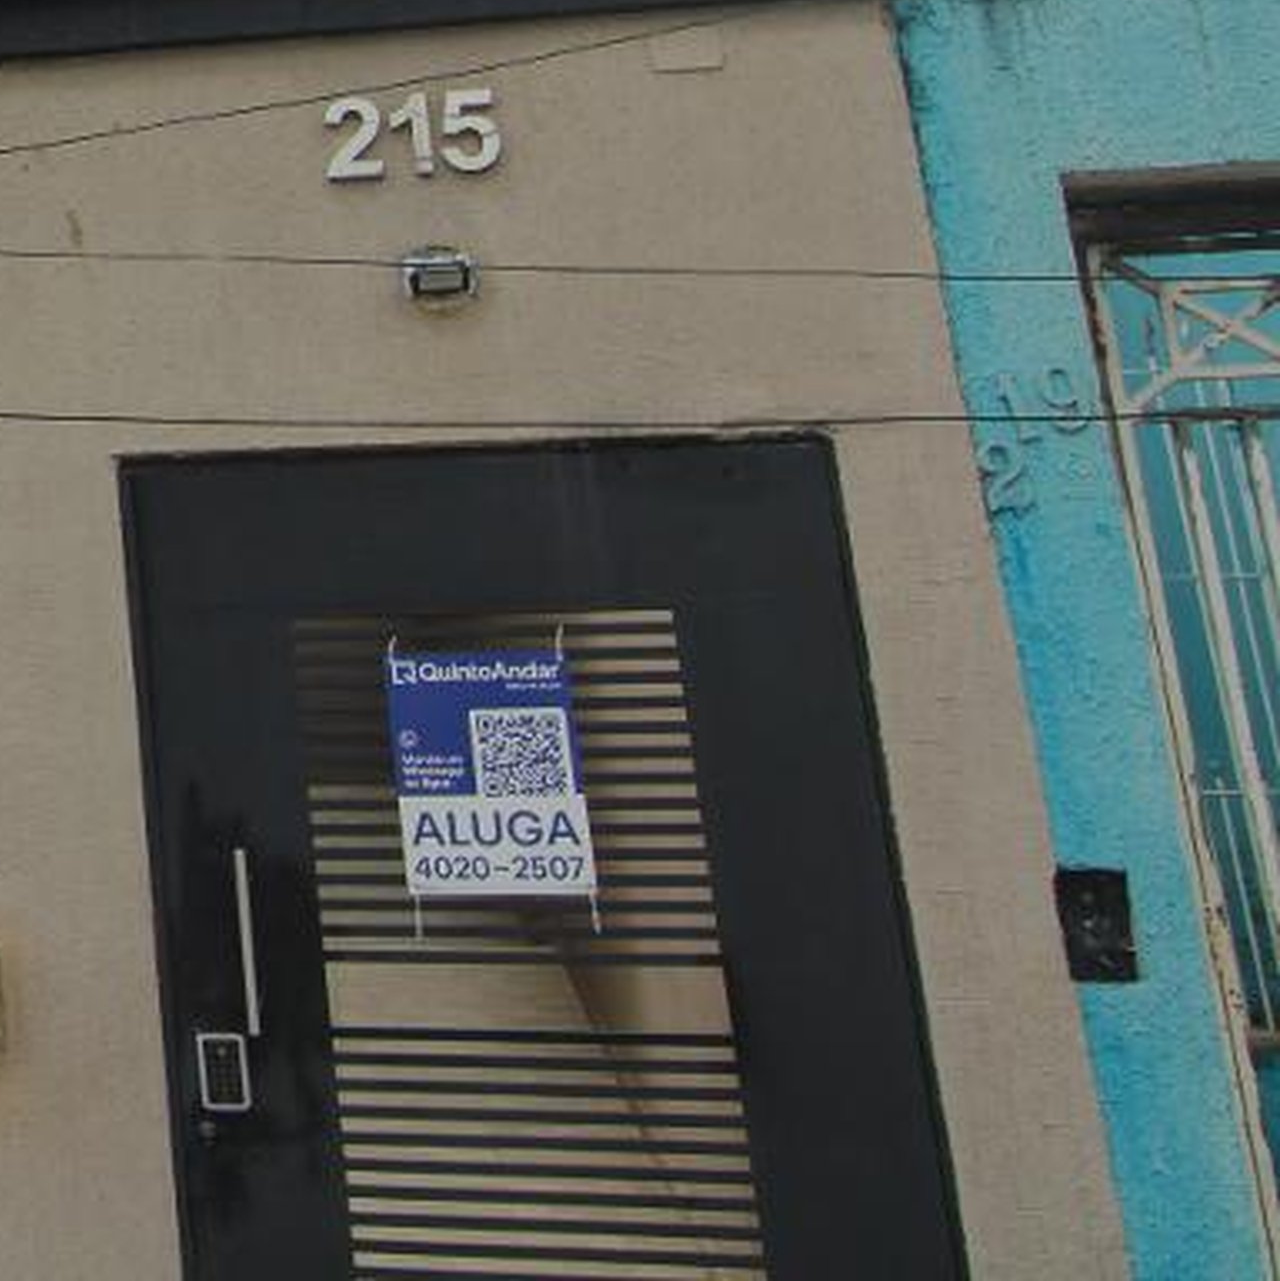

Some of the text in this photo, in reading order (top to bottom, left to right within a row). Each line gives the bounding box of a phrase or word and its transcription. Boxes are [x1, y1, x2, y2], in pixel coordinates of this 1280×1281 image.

[324, 89, 502, 180] 215
[418, 661, 560, 682] QuintoAndar
[413, 811, 580, 846] ALUGA
[414, 855, 584, 881] 4020-2507
